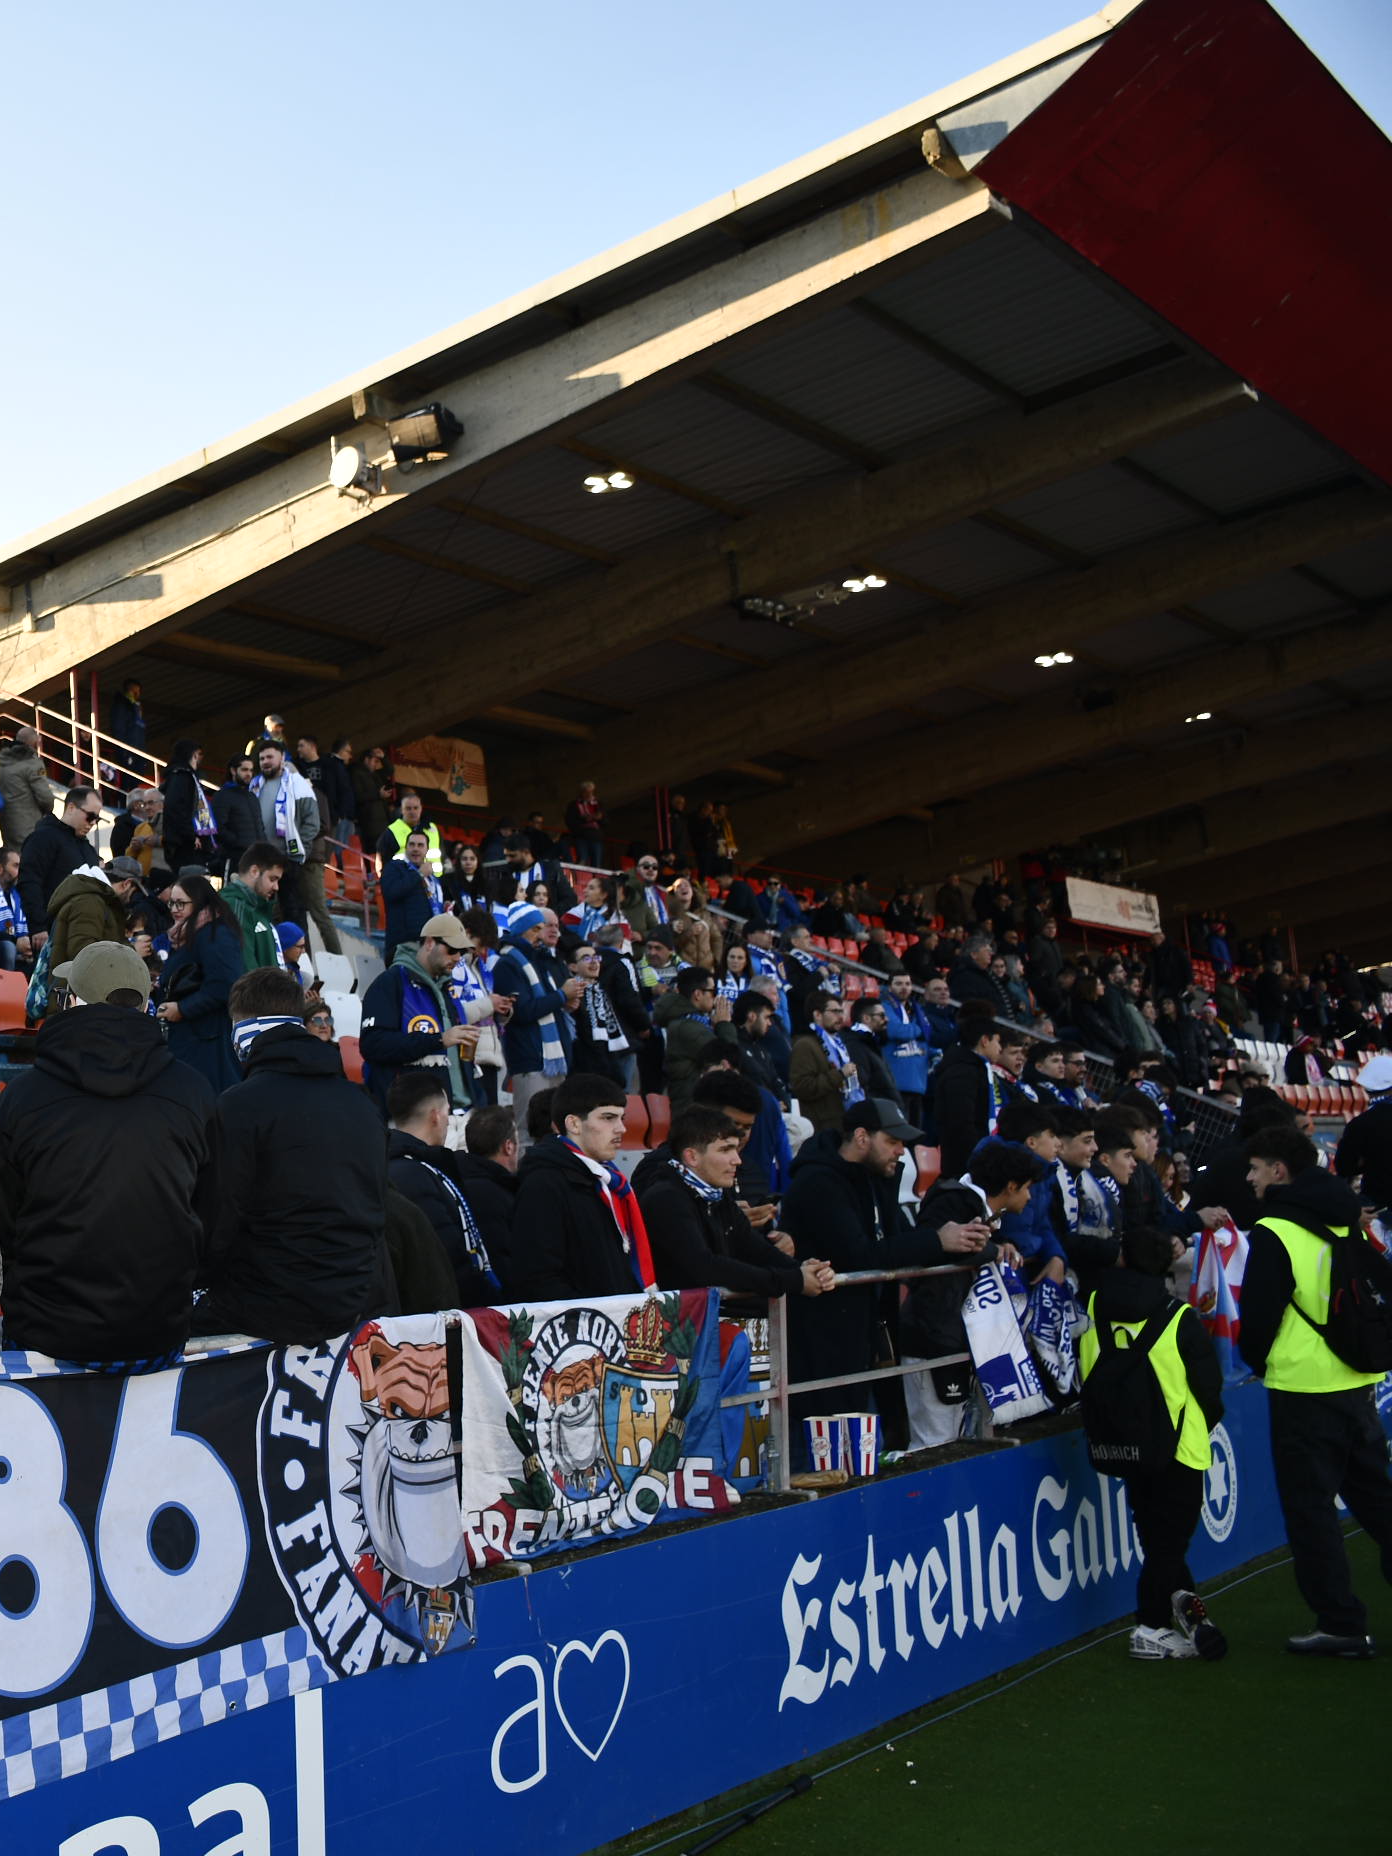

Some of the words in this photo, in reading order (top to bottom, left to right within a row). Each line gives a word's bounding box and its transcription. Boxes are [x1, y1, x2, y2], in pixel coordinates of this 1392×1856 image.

[577, 1310, 632, 1367] NORT
[276, 1499, 428, 1680] FANAT
[778, 1504, 1023, 1712] Estrella
